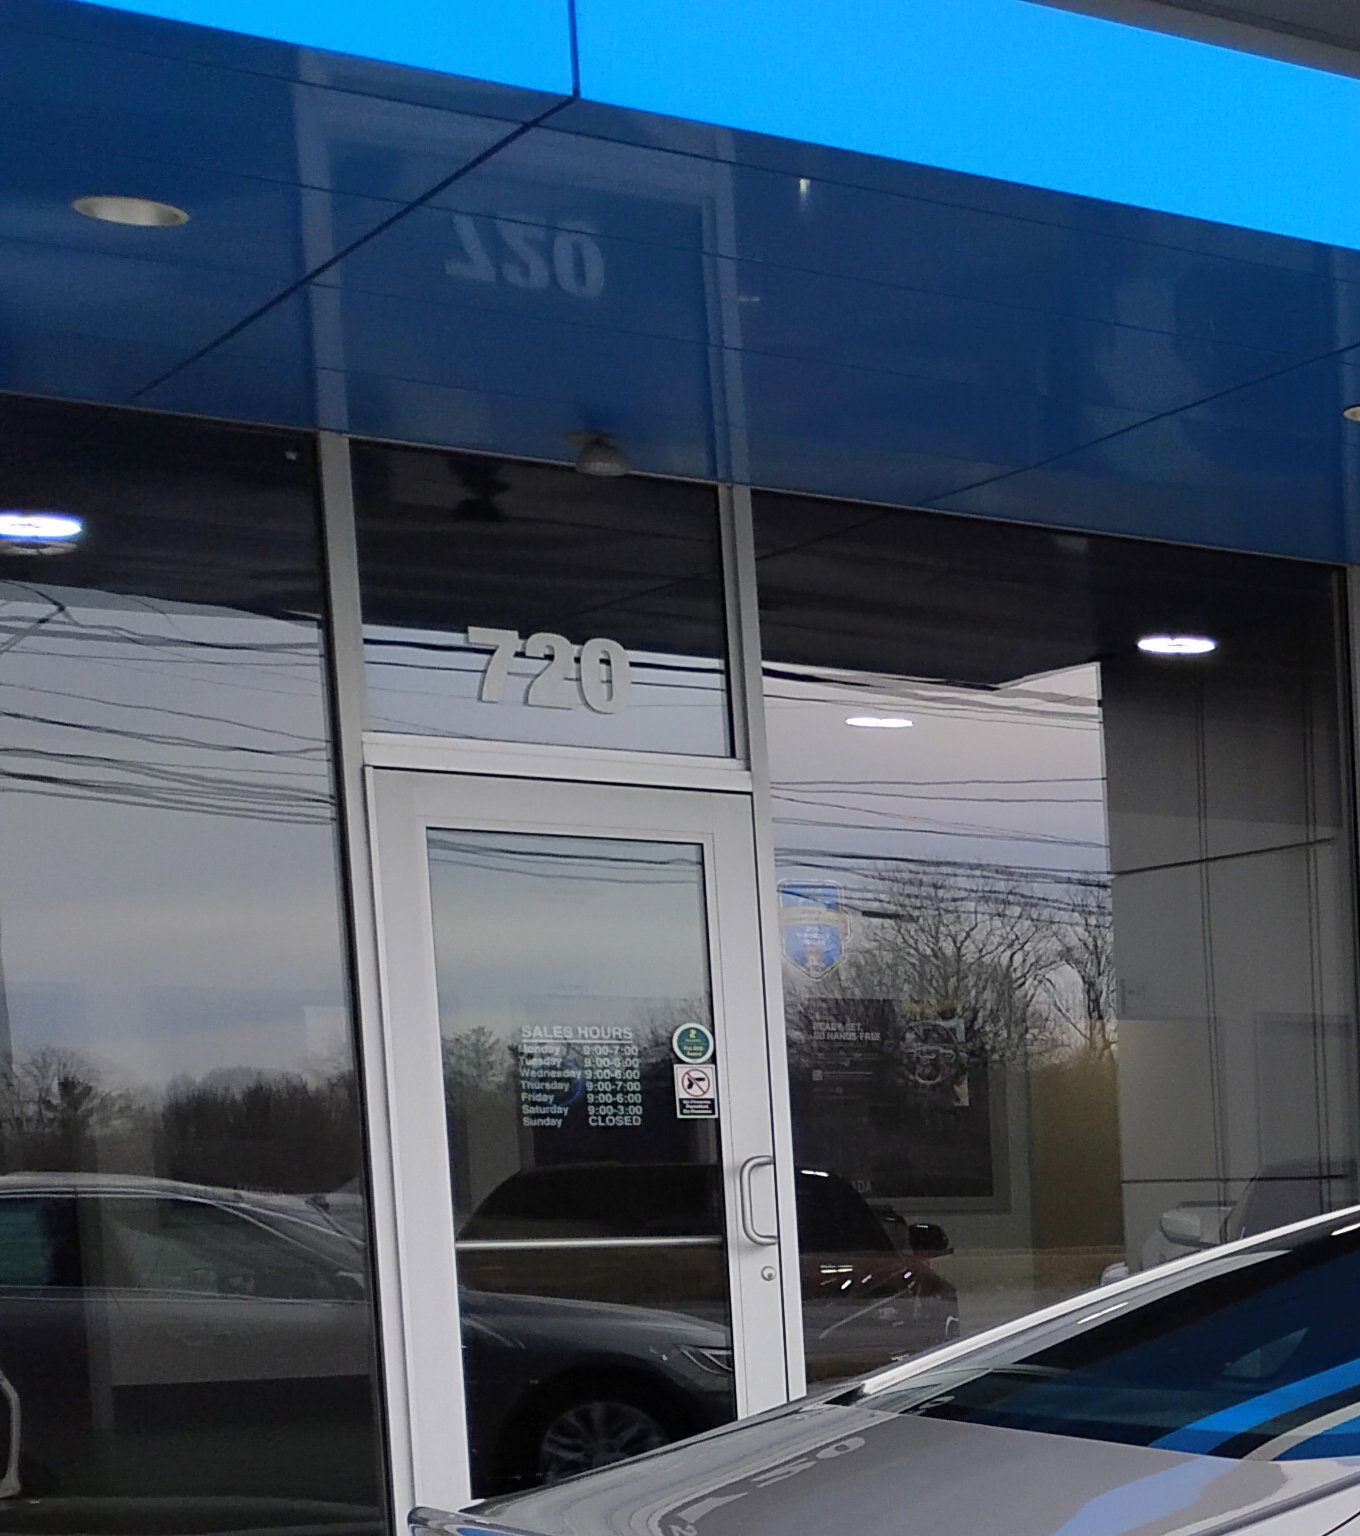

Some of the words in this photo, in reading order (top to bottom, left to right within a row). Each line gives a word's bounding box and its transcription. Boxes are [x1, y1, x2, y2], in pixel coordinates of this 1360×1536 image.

[466, 625, 632, 715] 720
[521, 1025, 574, 1039] SALES
[577, 1026, 633, 1039] HOURS
[518, 1044, 561, 1057] Monday
[583, 1045, 639, 1056] 9:00-7:00
[519, 1056, 562, 1068] Tuesday
[520, 1069, 582, 1080] Wednesday
[520, 1081, 570, 1092] Thursday
[585, 1081, 641, 1092] 9:00-7:00
[521, 1092, 555, 1104] Friday
[586, 1093, 642, 1103] 9:00-6:00
[521, 1104, 569, 1116] Saturday
[587, 1105, 643, 1115] 9:00-3:00
[522, 1116, 563, 1128] Sunday
[588, 1115, 641, 1126] CLOSED
